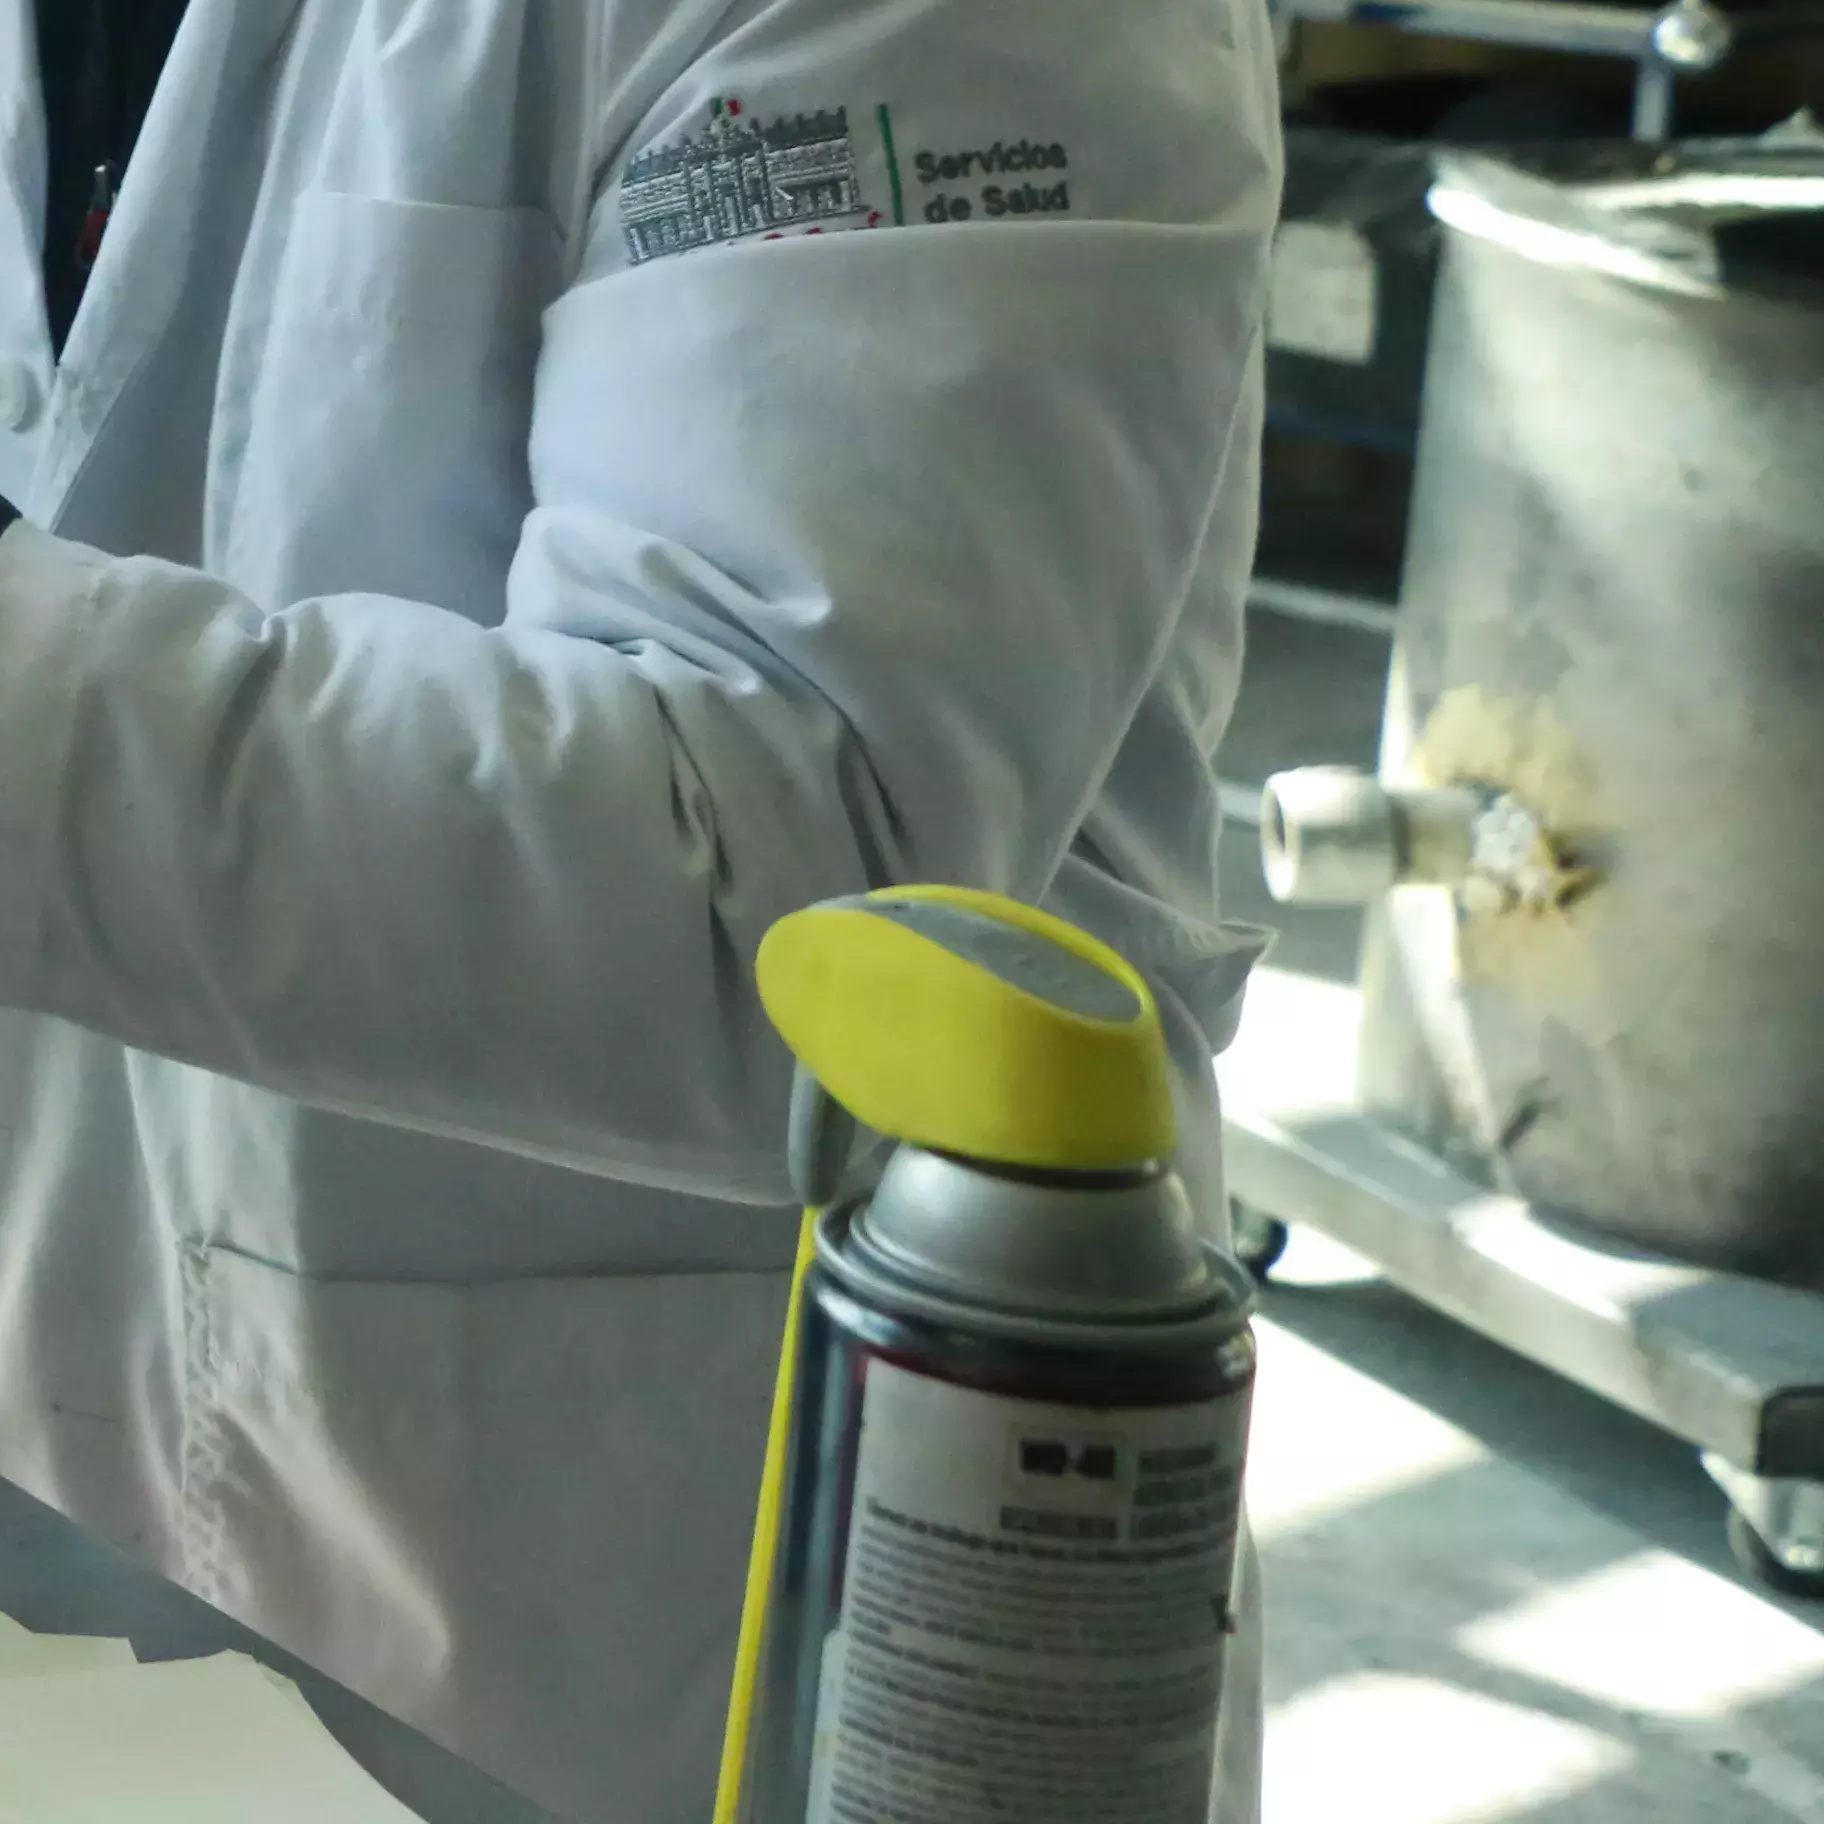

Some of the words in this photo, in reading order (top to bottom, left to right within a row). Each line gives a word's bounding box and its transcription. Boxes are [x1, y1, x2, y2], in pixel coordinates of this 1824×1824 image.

[915, 137, 1068, 183] Servicios
[924, 192, 972, 224] de
[981, 180, 1070, 217] Salud
